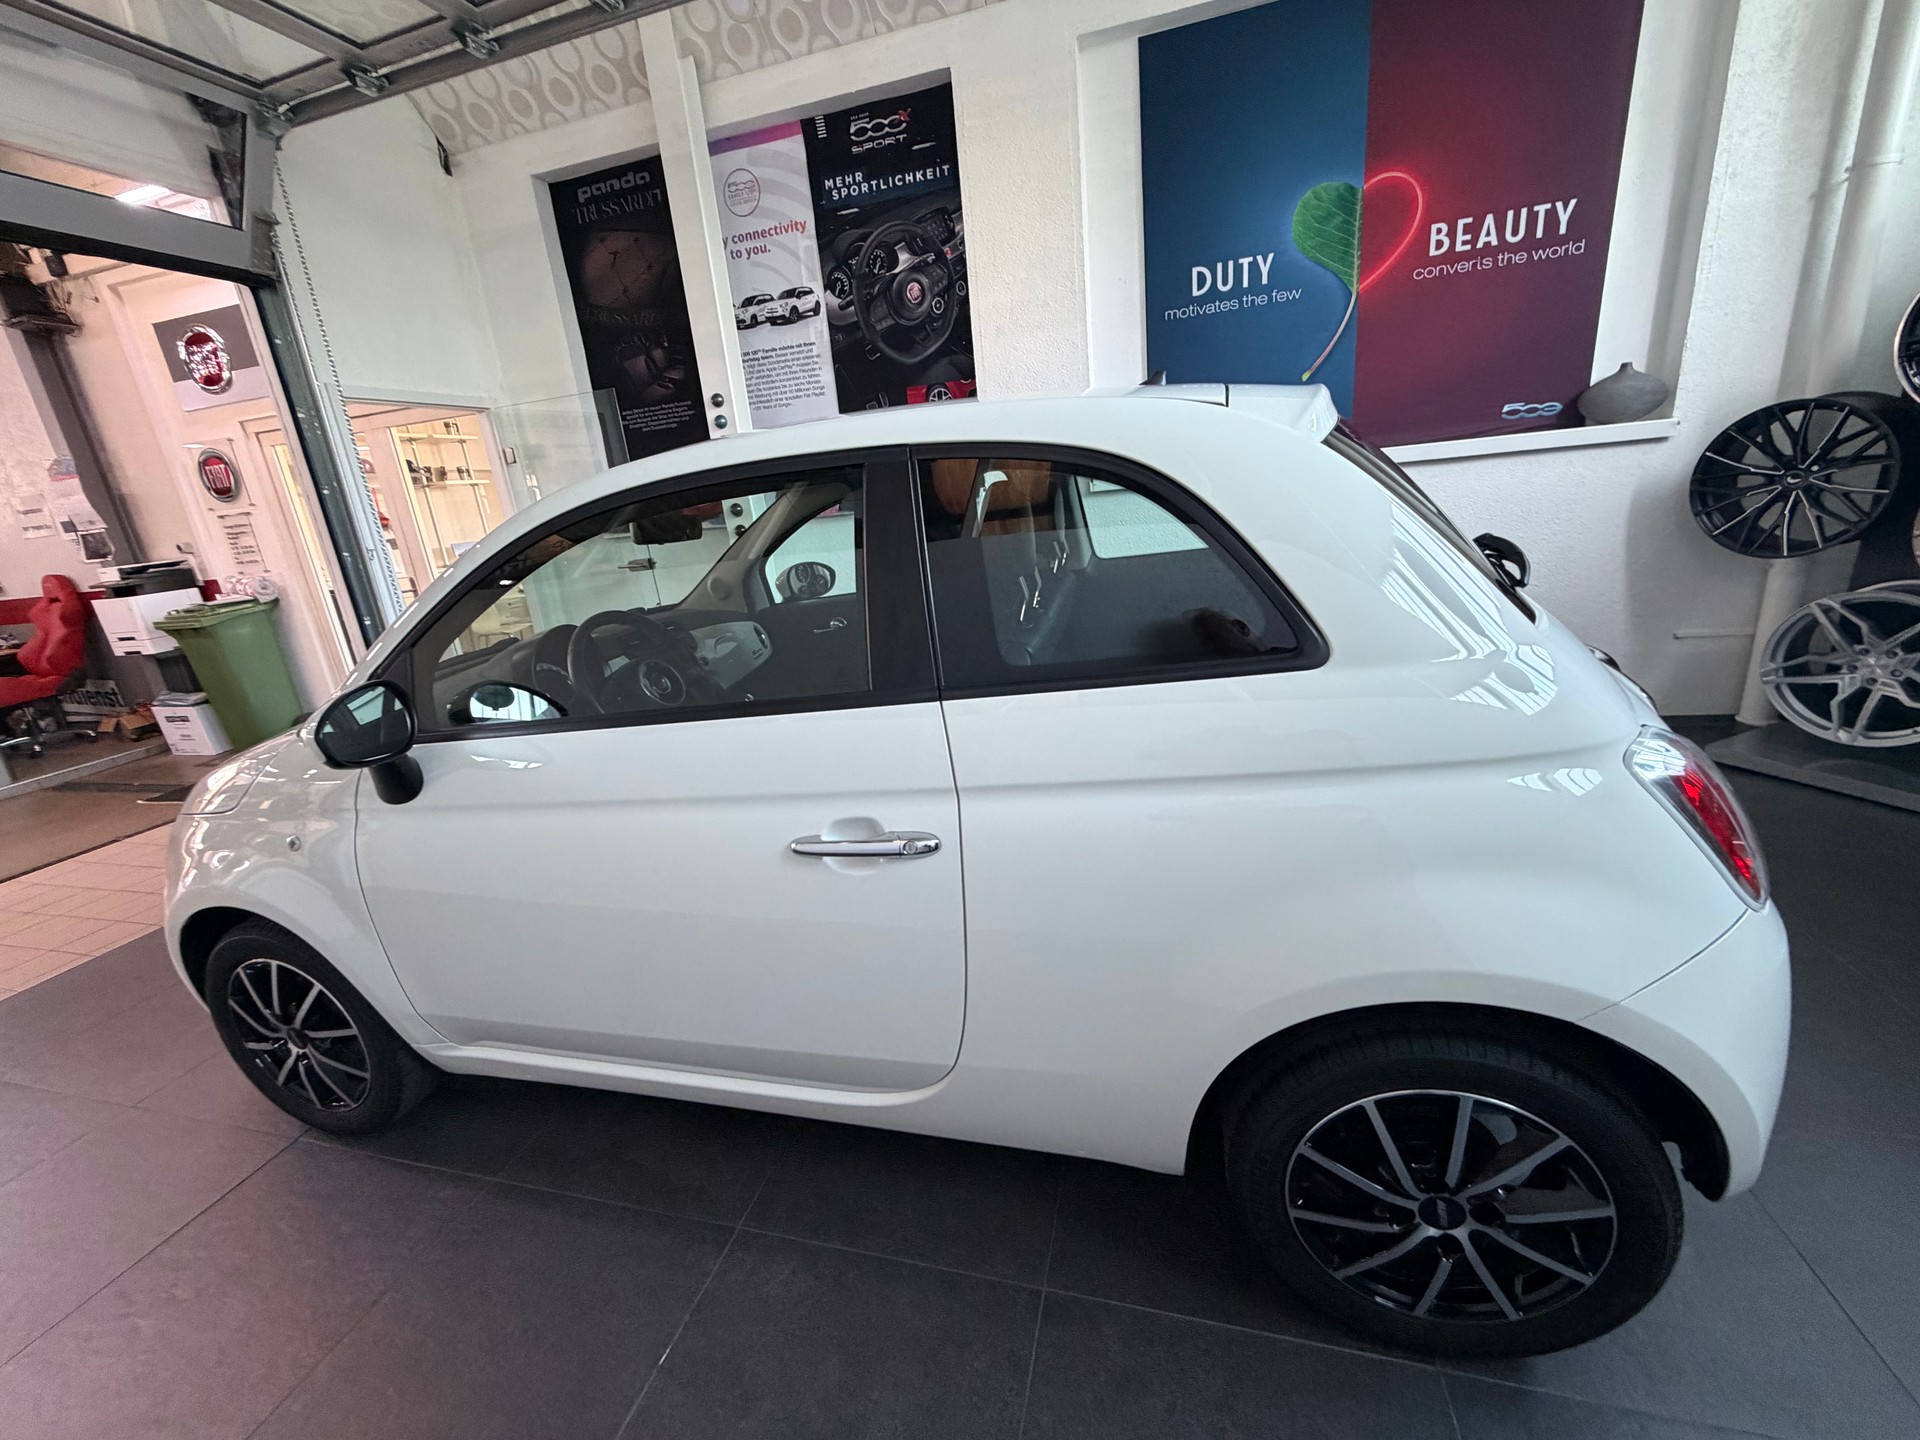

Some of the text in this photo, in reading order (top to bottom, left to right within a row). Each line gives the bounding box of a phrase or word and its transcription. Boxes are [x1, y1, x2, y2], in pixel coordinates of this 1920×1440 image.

[851, 133, 908, 155] SPORT
[576, 171, 651, 204] panda
[824, 171, 864, 191] MEHR
[831, 164, 950, 201] SPORTLICHKEIT
[731, 219, 807, 245] connectivity
[1428, 197, 1579, 257] BEAUTY
[729, 243, 771, 261] to you.
[1497, 251, 1528, 267] the
[1531, 238, 1586, 262] world
[1191, 251, 1276, 298] DUTY
[1163, 287, 1303, 321] motivates the few
[204, 463, 231, 489] FIAT
